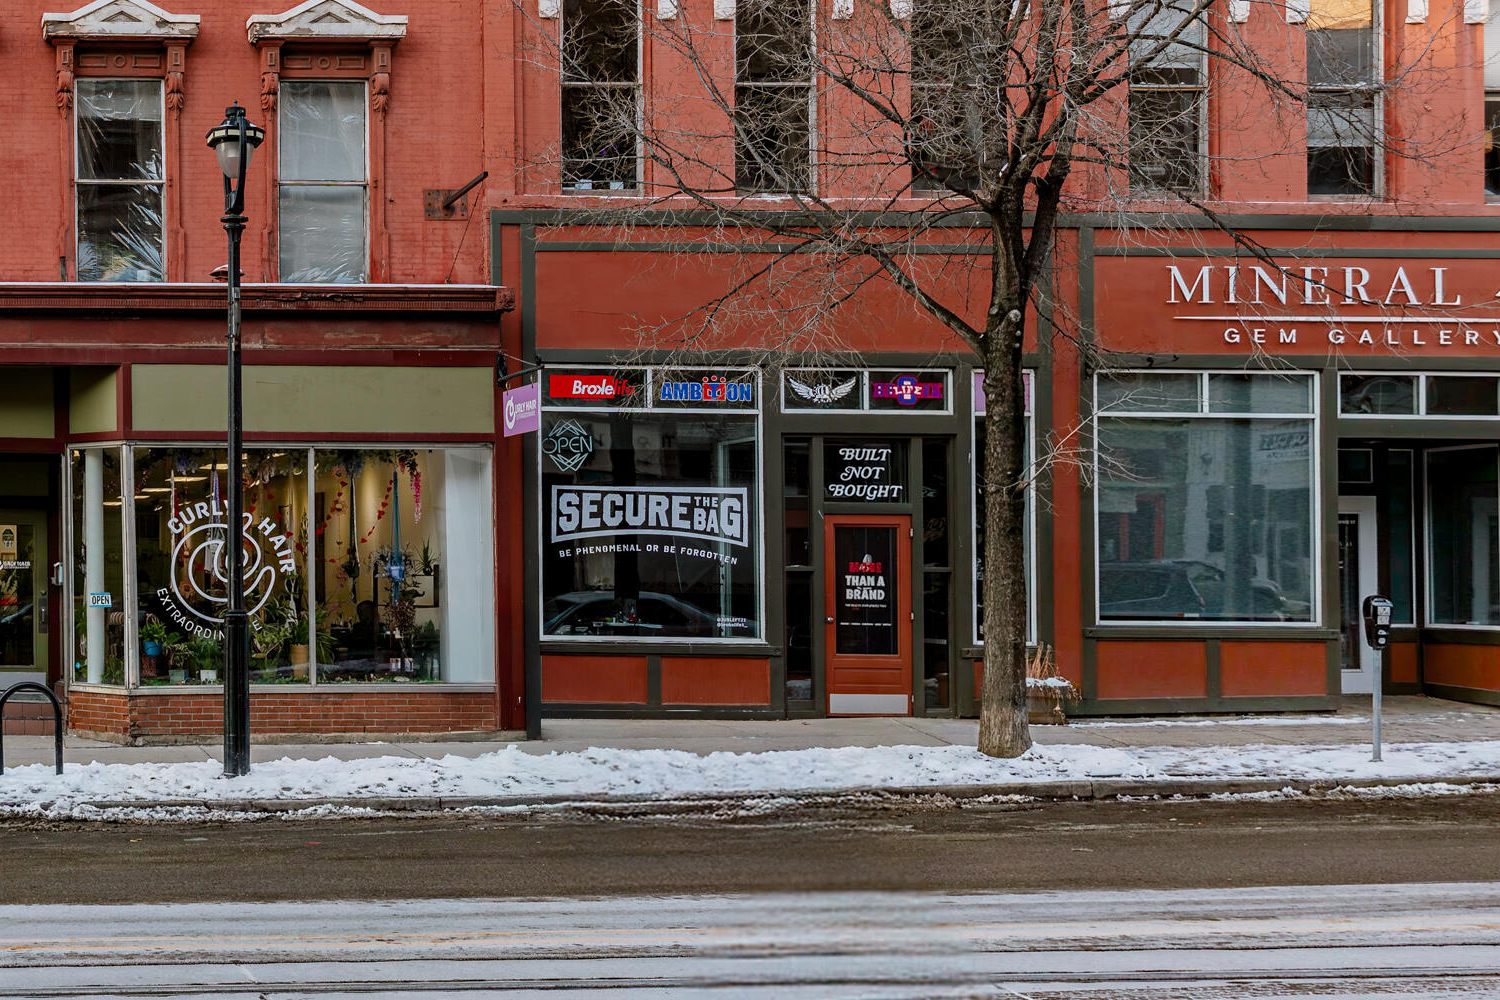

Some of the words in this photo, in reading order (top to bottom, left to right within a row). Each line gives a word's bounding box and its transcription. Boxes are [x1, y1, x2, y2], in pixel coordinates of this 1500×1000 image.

[1166, 265, 1461, 306] MINERAL
[1224, 327, 1297, 344] GEM
[541, 435, 593, 455] OPEN
[839, 448, 892, 461] BUILT
[840, 466, 885, 481] NOT
[828, 484, 903, 501] BOUGHT
[559, 492, 691, 532] SECURE
[694, 496, 719, 507] THE
[693, 497, 741, 539] BAG
[257, 516, 296, 573] HAIR
[559, 550, 572, 558] BE
[576, 544, 642, 556] PHENOMENAL
[646, 544, 659, 553] OR
[663, 545, 676, 554] BE
[680, 547, 738, 565] FORGOTTEN
[845, 575, 875, 587] THAN
[876, 575, 886, 588] A
[91, 595, 110, 605] OPEN
[846, 588, 886, 601] BRAND
